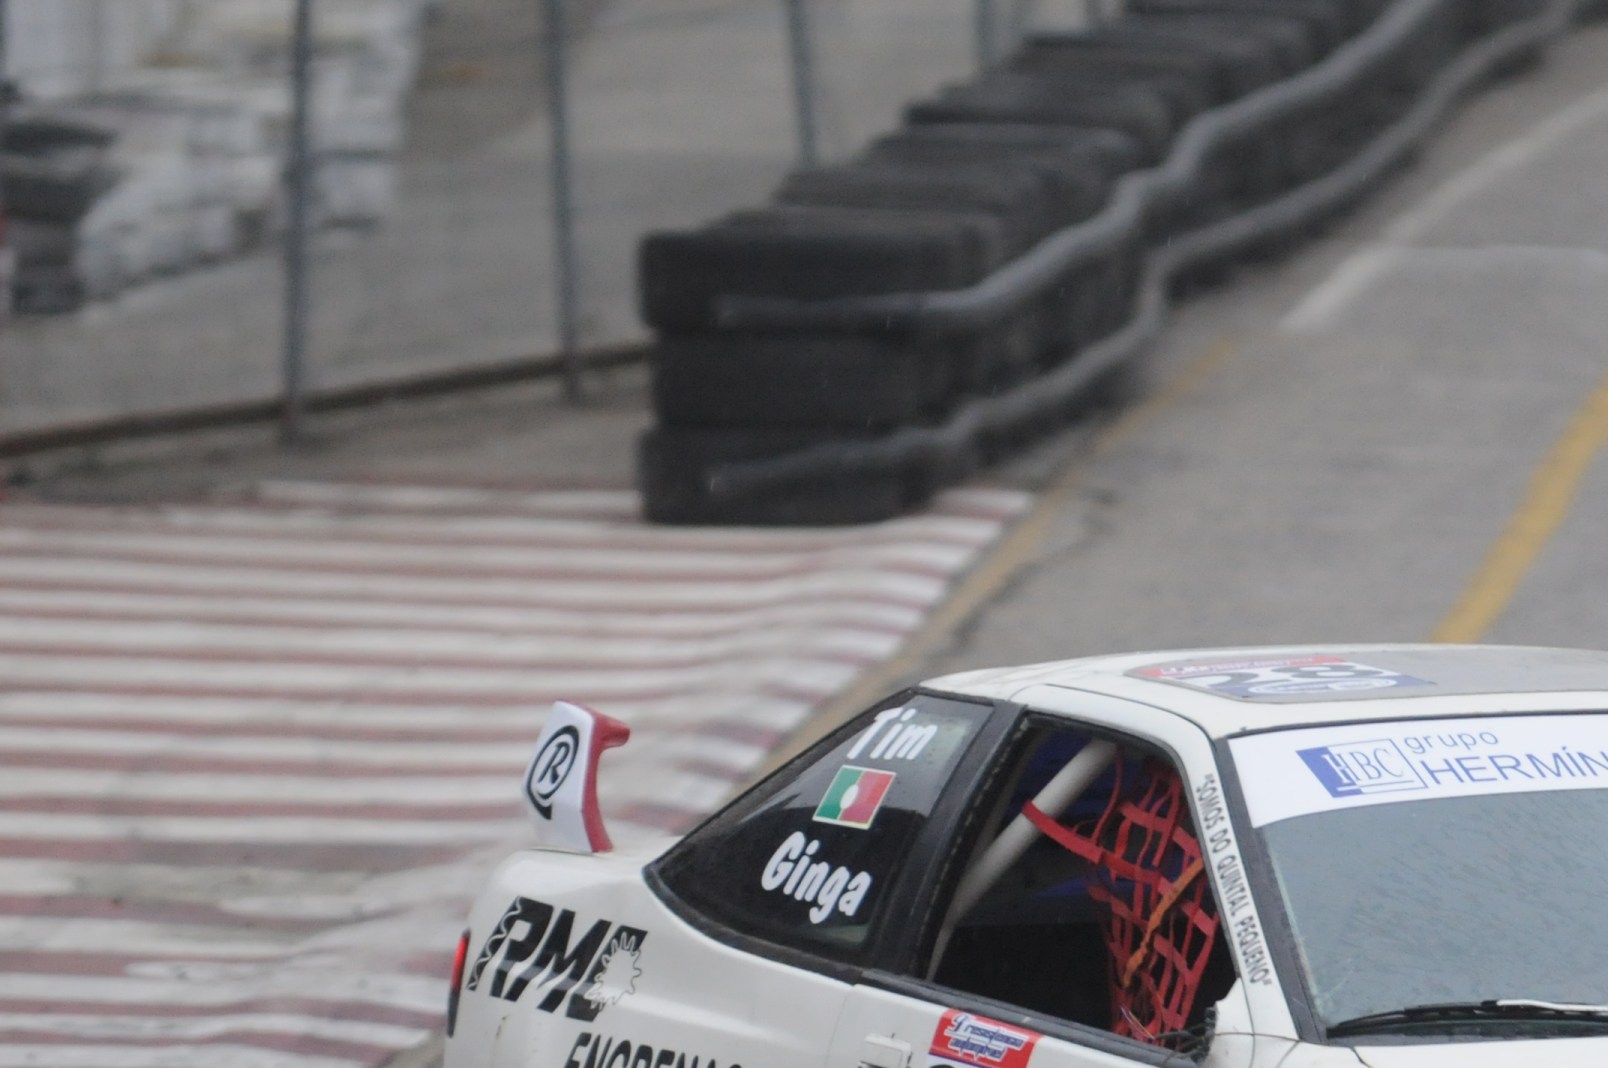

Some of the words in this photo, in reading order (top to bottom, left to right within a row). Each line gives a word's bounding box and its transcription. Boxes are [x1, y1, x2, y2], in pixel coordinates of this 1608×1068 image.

[846, 707, 938, 760] Tim
[1403, 729, 1499, 755] grupo
[1209, 828, 1232, 854] DO
[761, 831, 873, 924] Ginga
[1216, 854, 1250, 917] QUINTAL
